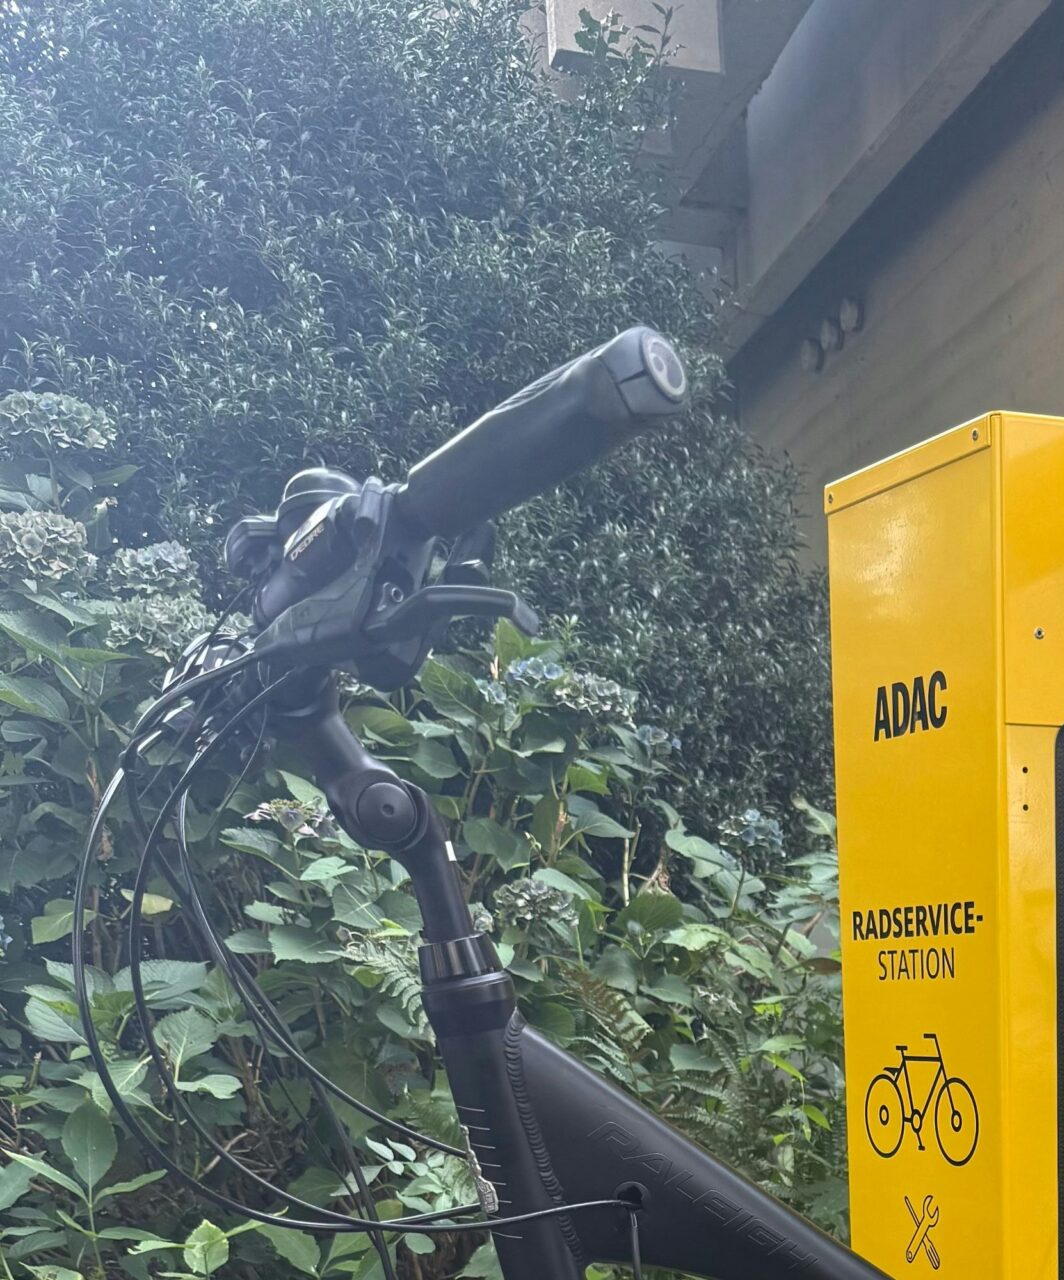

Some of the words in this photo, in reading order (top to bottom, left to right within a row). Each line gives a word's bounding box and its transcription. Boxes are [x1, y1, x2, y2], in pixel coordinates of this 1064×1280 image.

[873, 670, 948, 742] ADAC
[852, 901, 984, 941] RADSERVICE-
[878, 947, 955, 981] STATION
[586, 1121, 820, 1269] RALEIGH
